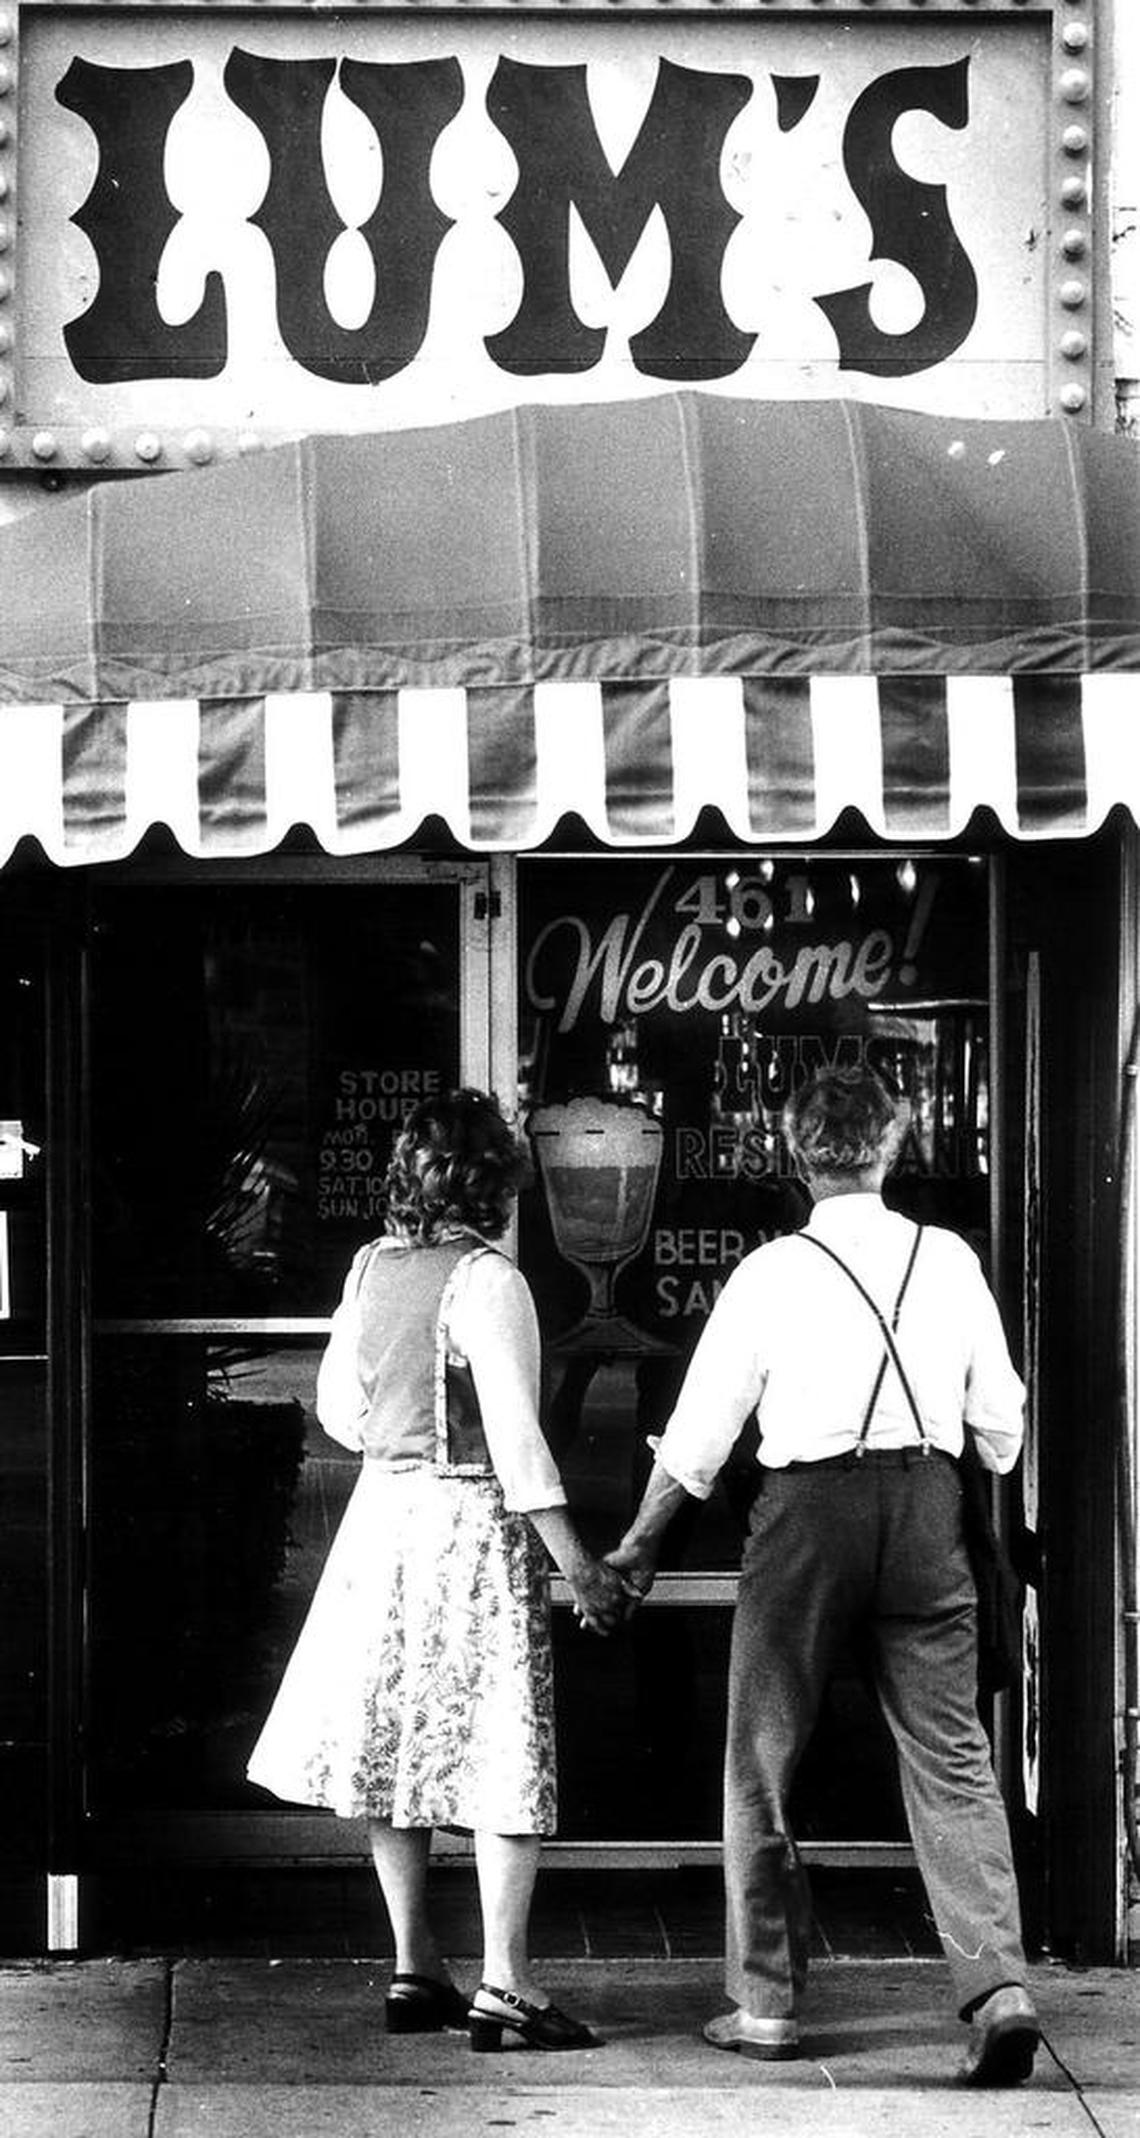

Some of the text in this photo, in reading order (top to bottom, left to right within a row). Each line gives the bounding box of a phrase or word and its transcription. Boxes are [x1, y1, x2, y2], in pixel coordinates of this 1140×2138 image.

[54, 46, 979, 385] LUM'S
[676, 874, 814, 928] 461
[526, 865, 940, 1033] Welcome!
[339, 1070, 440, 1094] STORE
[654, 1228, 745, 1266] BEER
